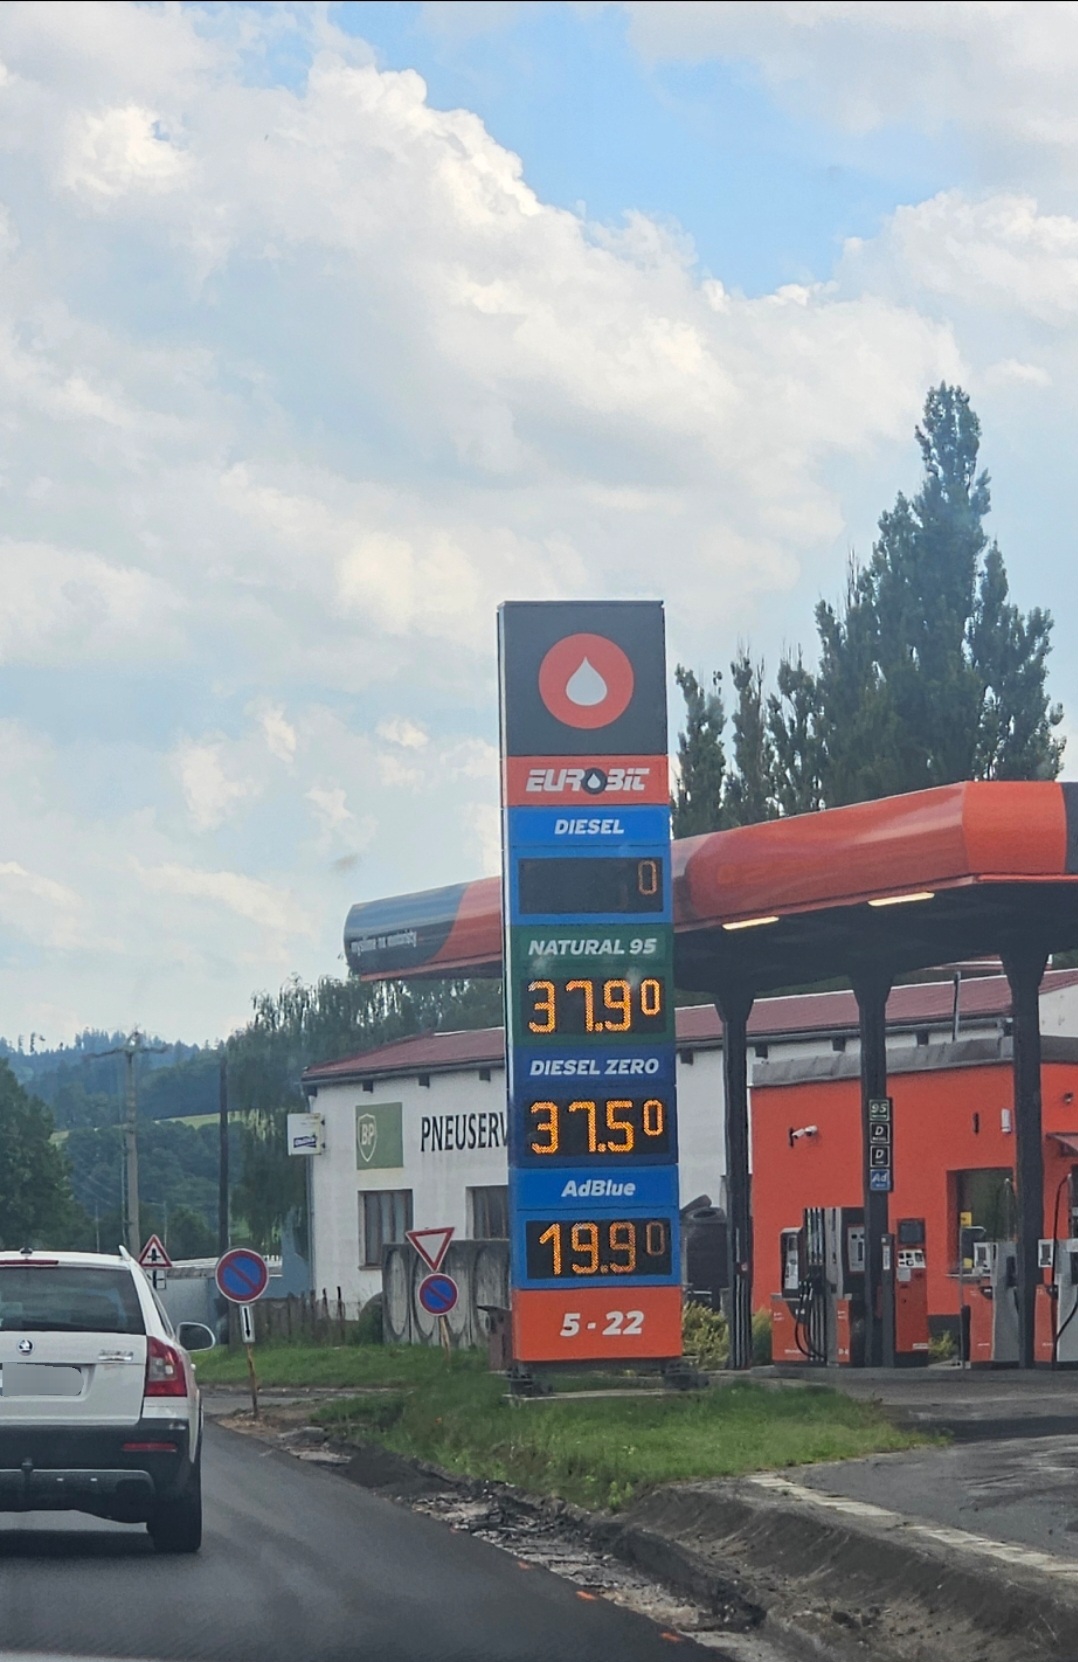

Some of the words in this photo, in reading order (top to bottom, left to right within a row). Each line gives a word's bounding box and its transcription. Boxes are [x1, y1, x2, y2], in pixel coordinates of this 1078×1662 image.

[554, 819, 625, 835] DIESEL
[528, 939, 625, 956] NATURAL
[629, 938, 657, 954] 95
[530, 1059, 600, 1075] DIESEL
[604, 1058, 659, 1075] ZERO
[871, 1102, 887, 1114] 95
[361, 1123, 375, 1146] BP
[875, 1126, 884, 1136] D
[875, 1149, 884, 1159] D
[872, 1173, 887, 1183] Ad
[561, 1179, 636, 1197] AdBlue
[602, 1310, 645, 1336] 22
